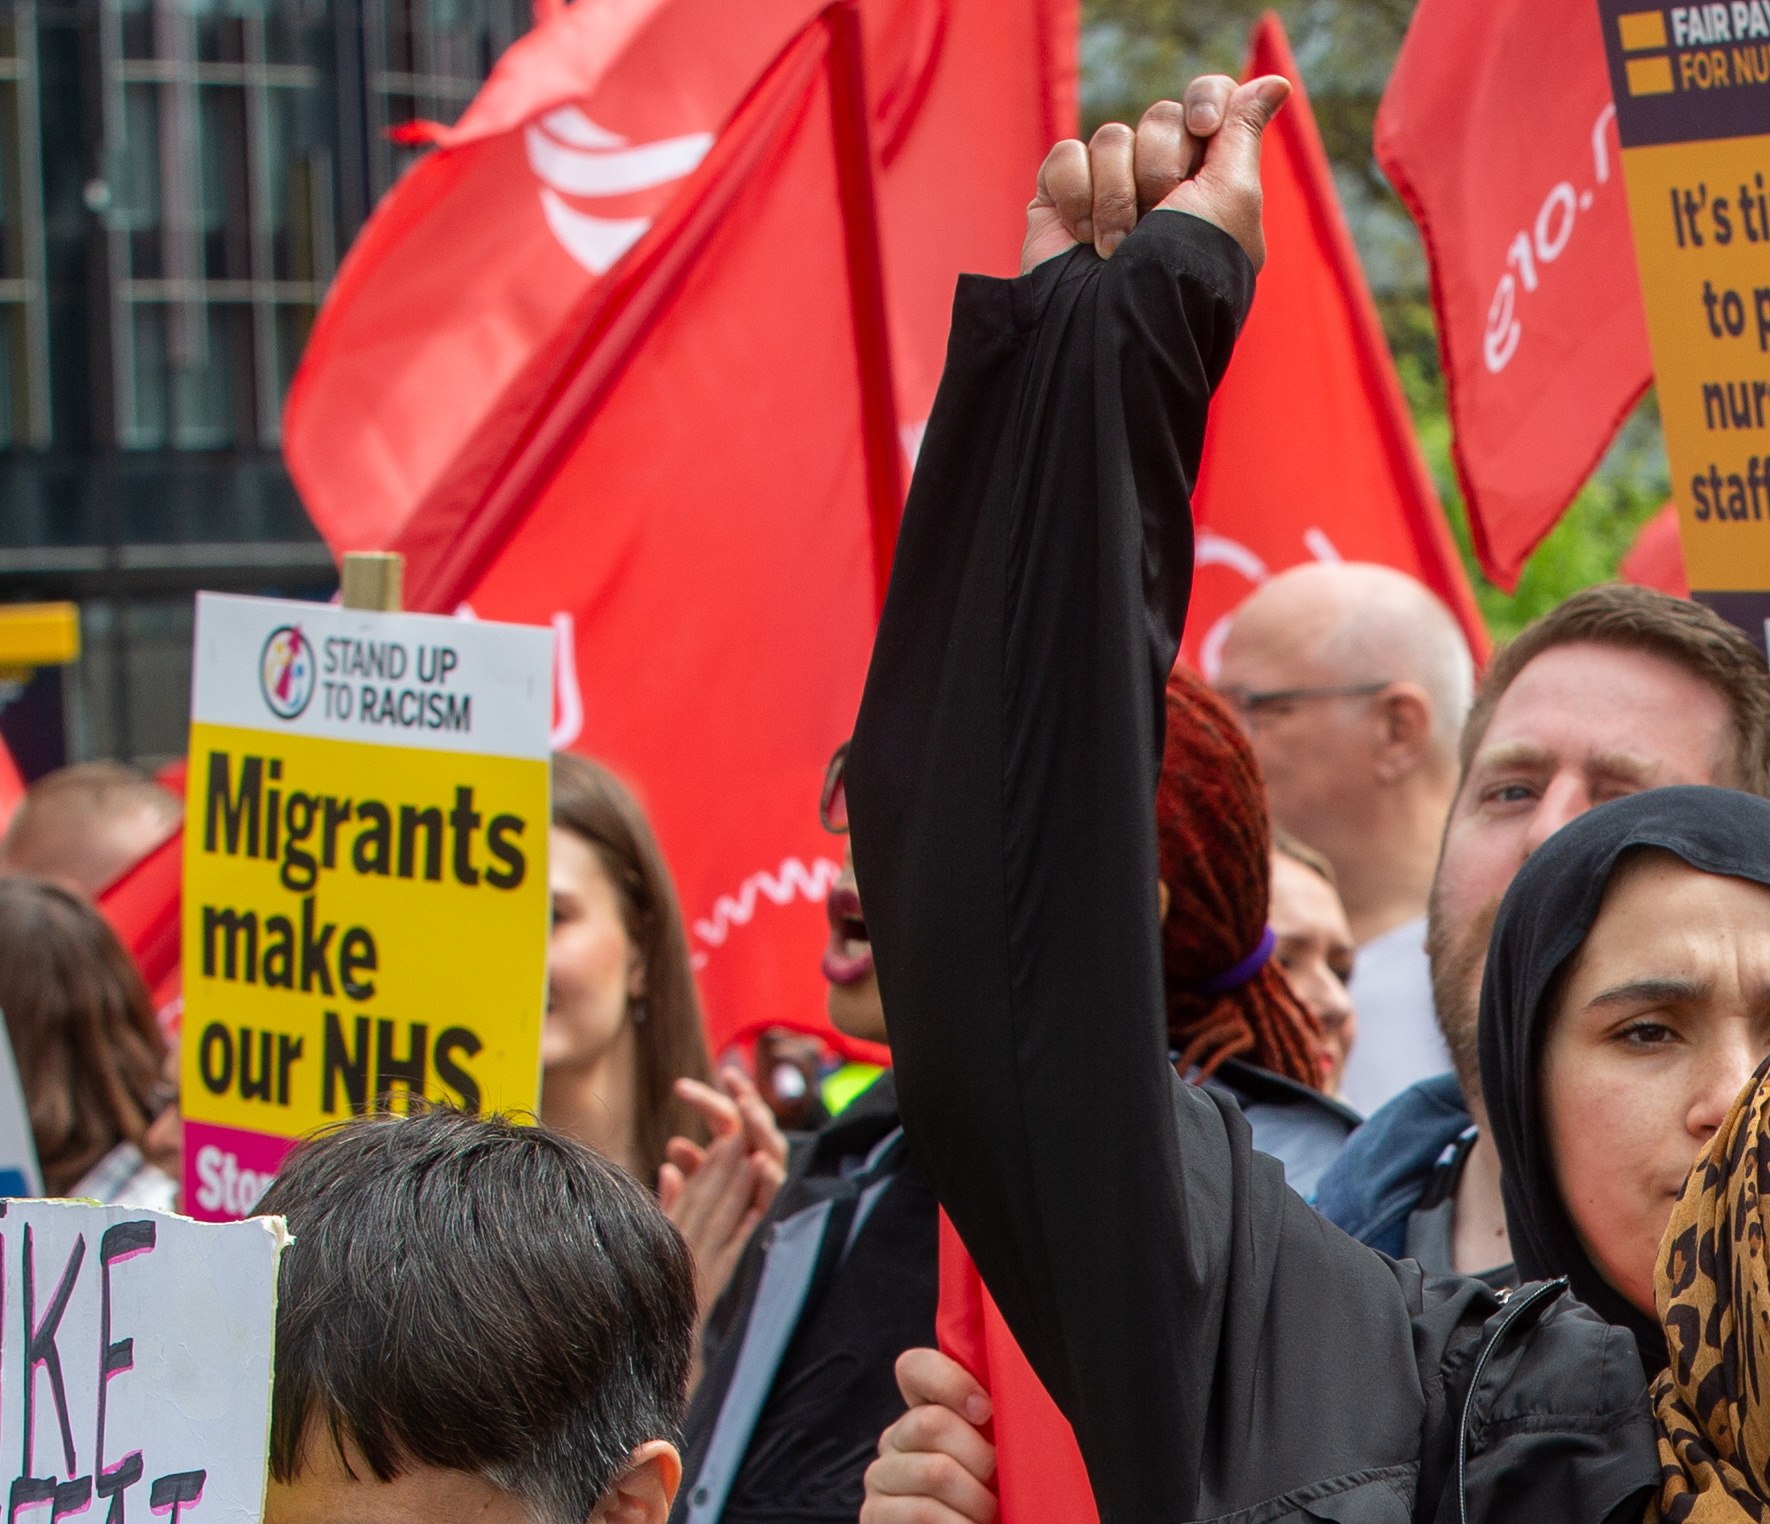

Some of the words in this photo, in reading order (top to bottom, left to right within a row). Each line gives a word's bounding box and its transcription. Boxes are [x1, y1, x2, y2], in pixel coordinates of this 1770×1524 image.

[1671, 4, 1731, 47] FAIR
[1679, 50, 1730, 90] FOR
[1670, 182, 1734, 248] It's
[1702, 280, 1745, 338] to
[324, 636, 408, 682] STAND
[417, 643, 457, 684] UP
[323, 680, 353, 720] TO
[360, 686, 472, 732] RACISM
[203, 750, 527, 893] Migrants
[201, 893, 379, 1002] make
[199, 1022, 305, 1106] our
[321, 1010, 484, 1121] NHS
[0, 1220, 155, 1498] KE
